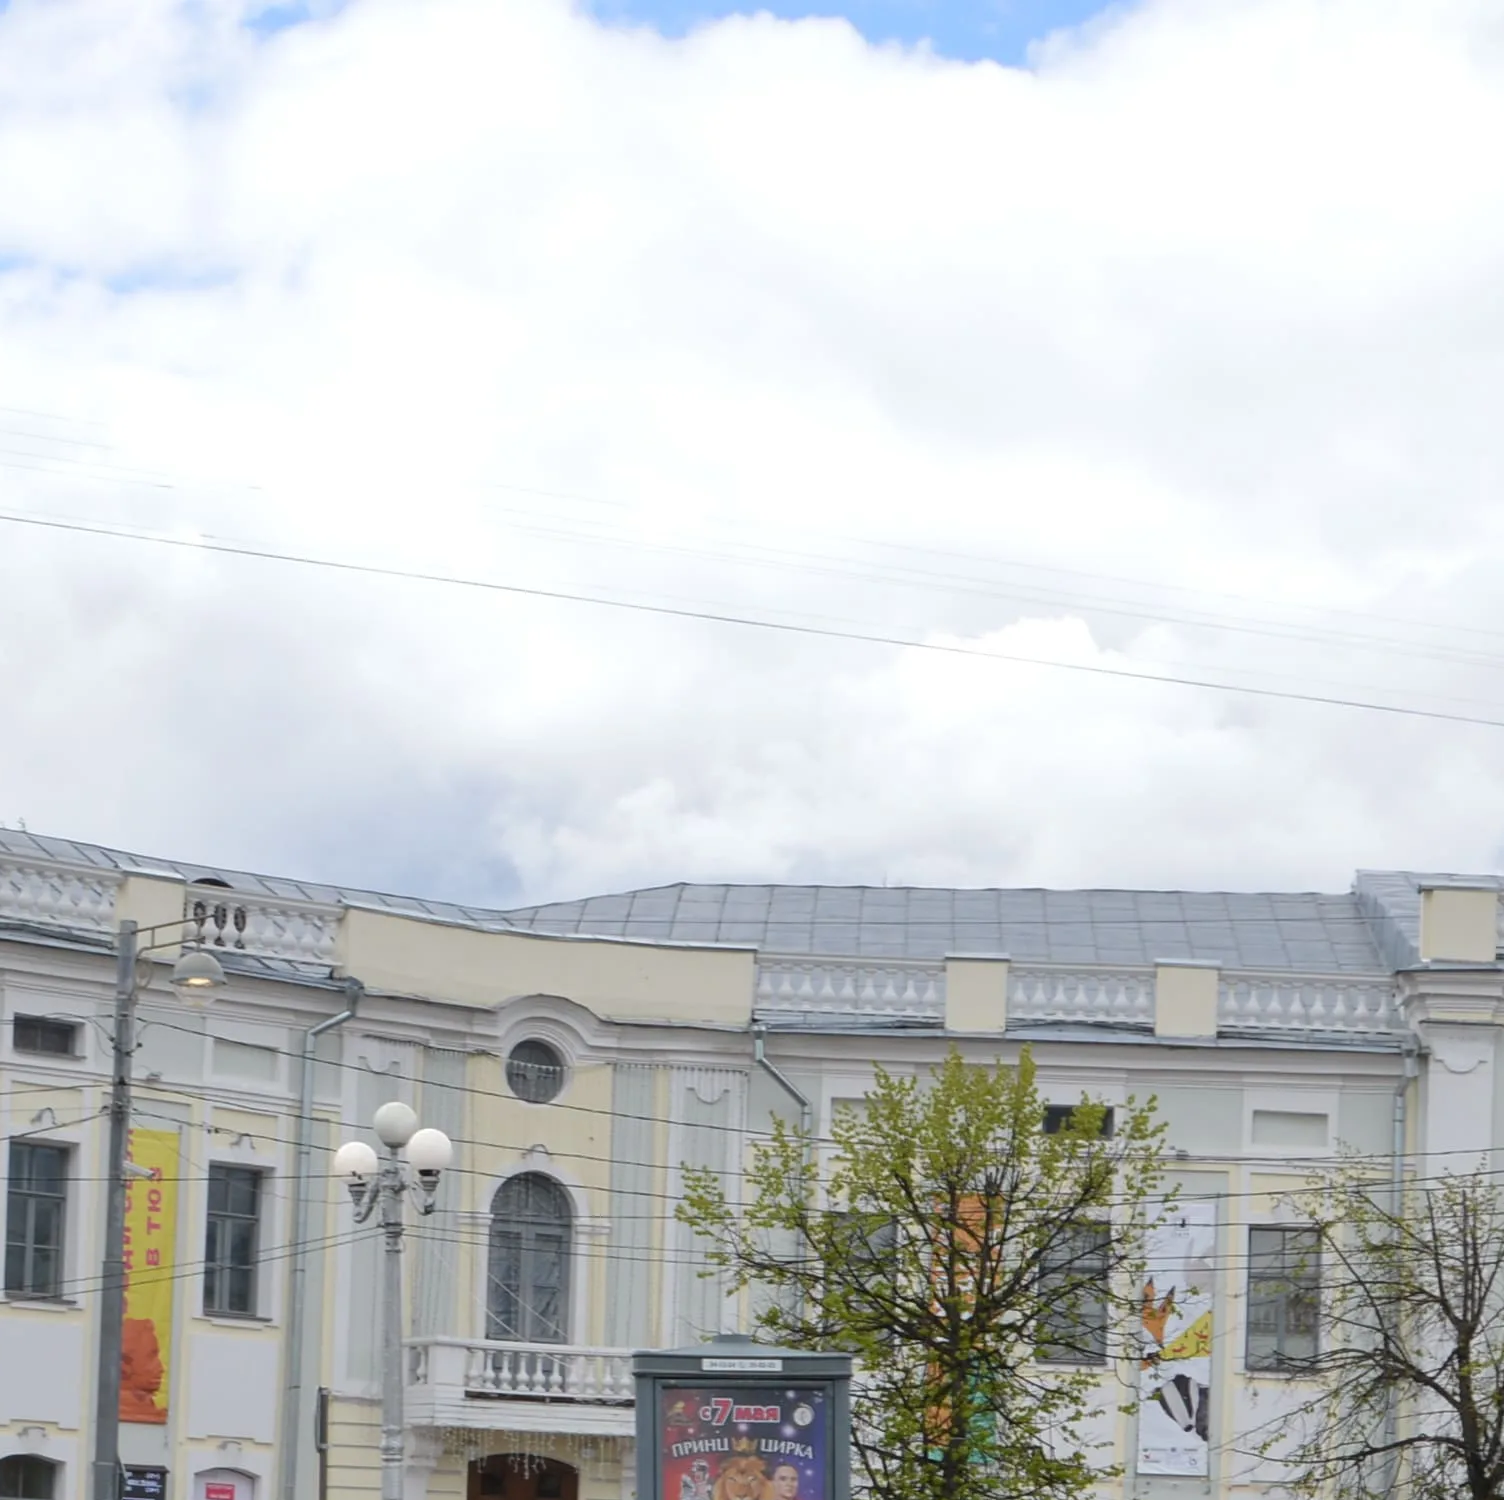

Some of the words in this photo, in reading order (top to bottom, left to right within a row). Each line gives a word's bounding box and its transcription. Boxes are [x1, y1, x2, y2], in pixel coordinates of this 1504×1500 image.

[711, 1397, 733, 1426] 7
[671, 1437, 729, 1458] ПРИНЦ
[760, 1438, 814, 1460] ЦИРКА
